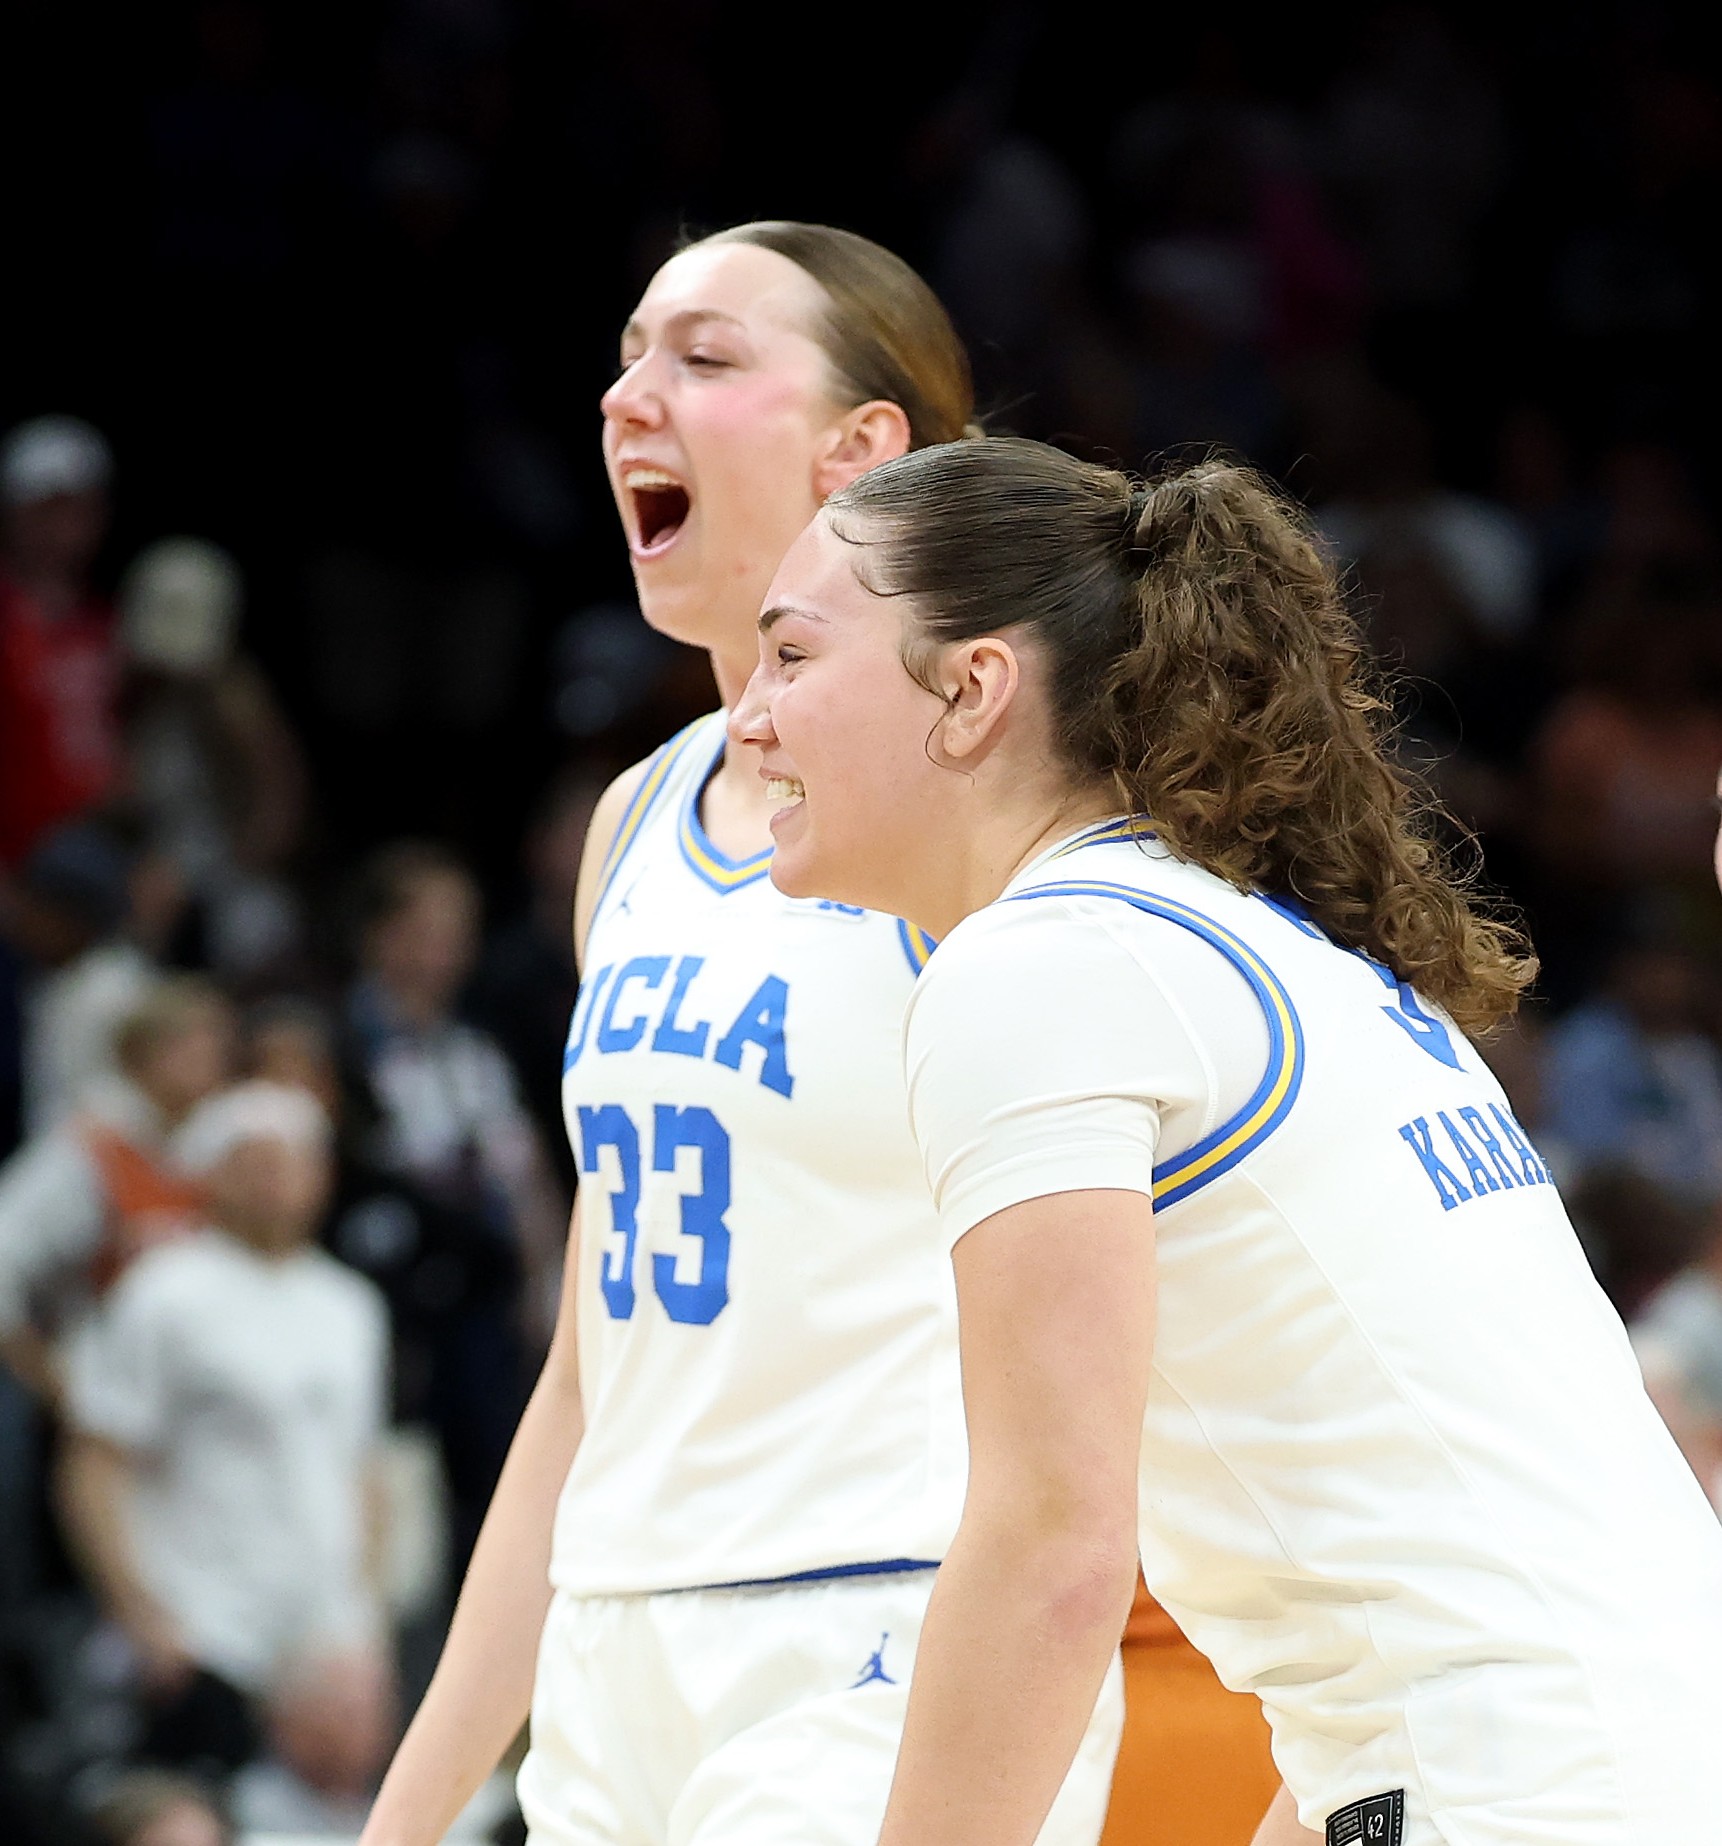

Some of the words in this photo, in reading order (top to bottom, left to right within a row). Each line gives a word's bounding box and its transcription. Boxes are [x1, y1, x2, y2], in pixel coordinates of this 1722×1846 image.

[561, 955, 794, 1100] UCLA
[577, 1104, 731, 1326] 33
[1398, 1102, 1555, 1212] KARA
[1367, 1813, 1385, 1839] 42
